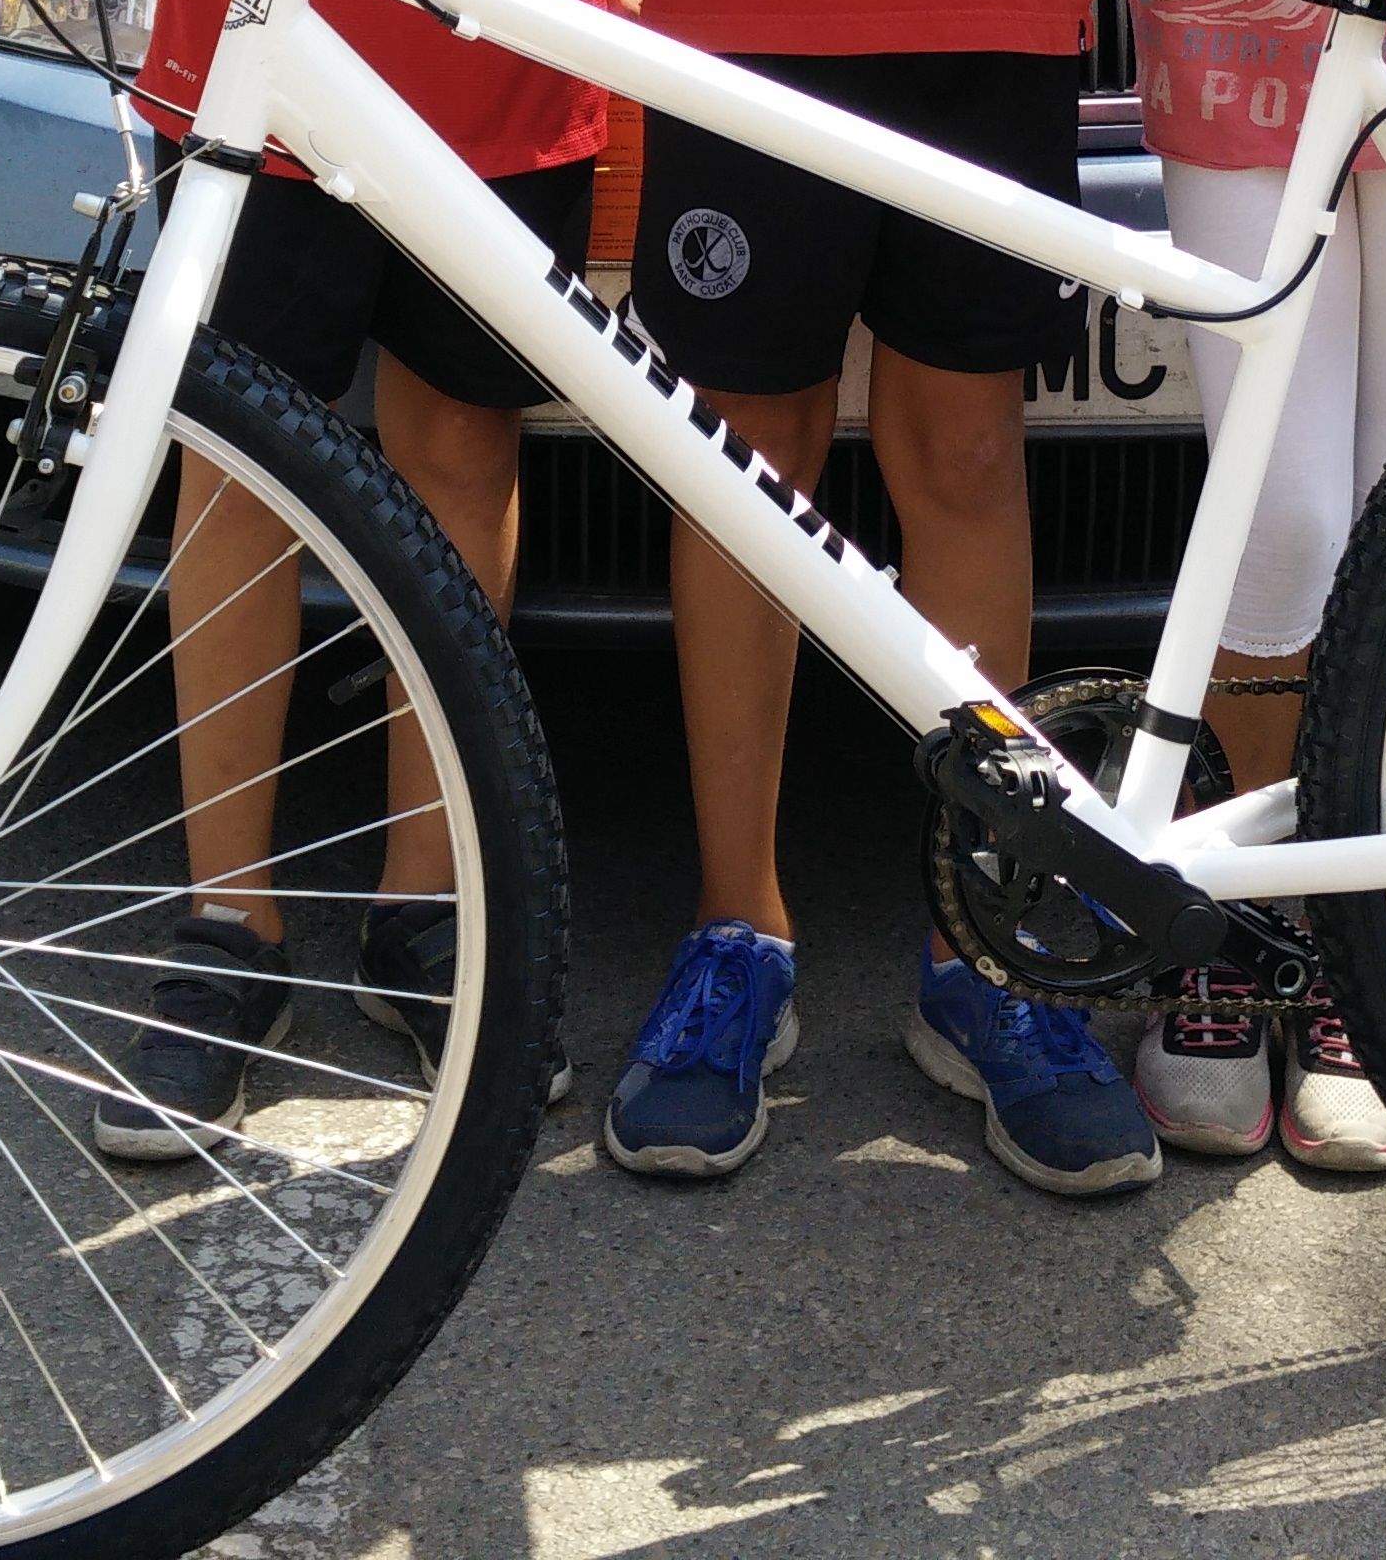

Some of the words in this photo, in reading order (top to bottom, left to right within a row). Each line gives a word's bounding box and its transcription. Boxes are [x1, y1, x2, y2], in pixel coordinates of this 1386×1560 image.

[1180, 27, 1284, 65] SURF
[727, 228, 746, 256] CLUB
[674, 262, 696, 289] SANT
[700, 274, 736, 296] CUGAT
